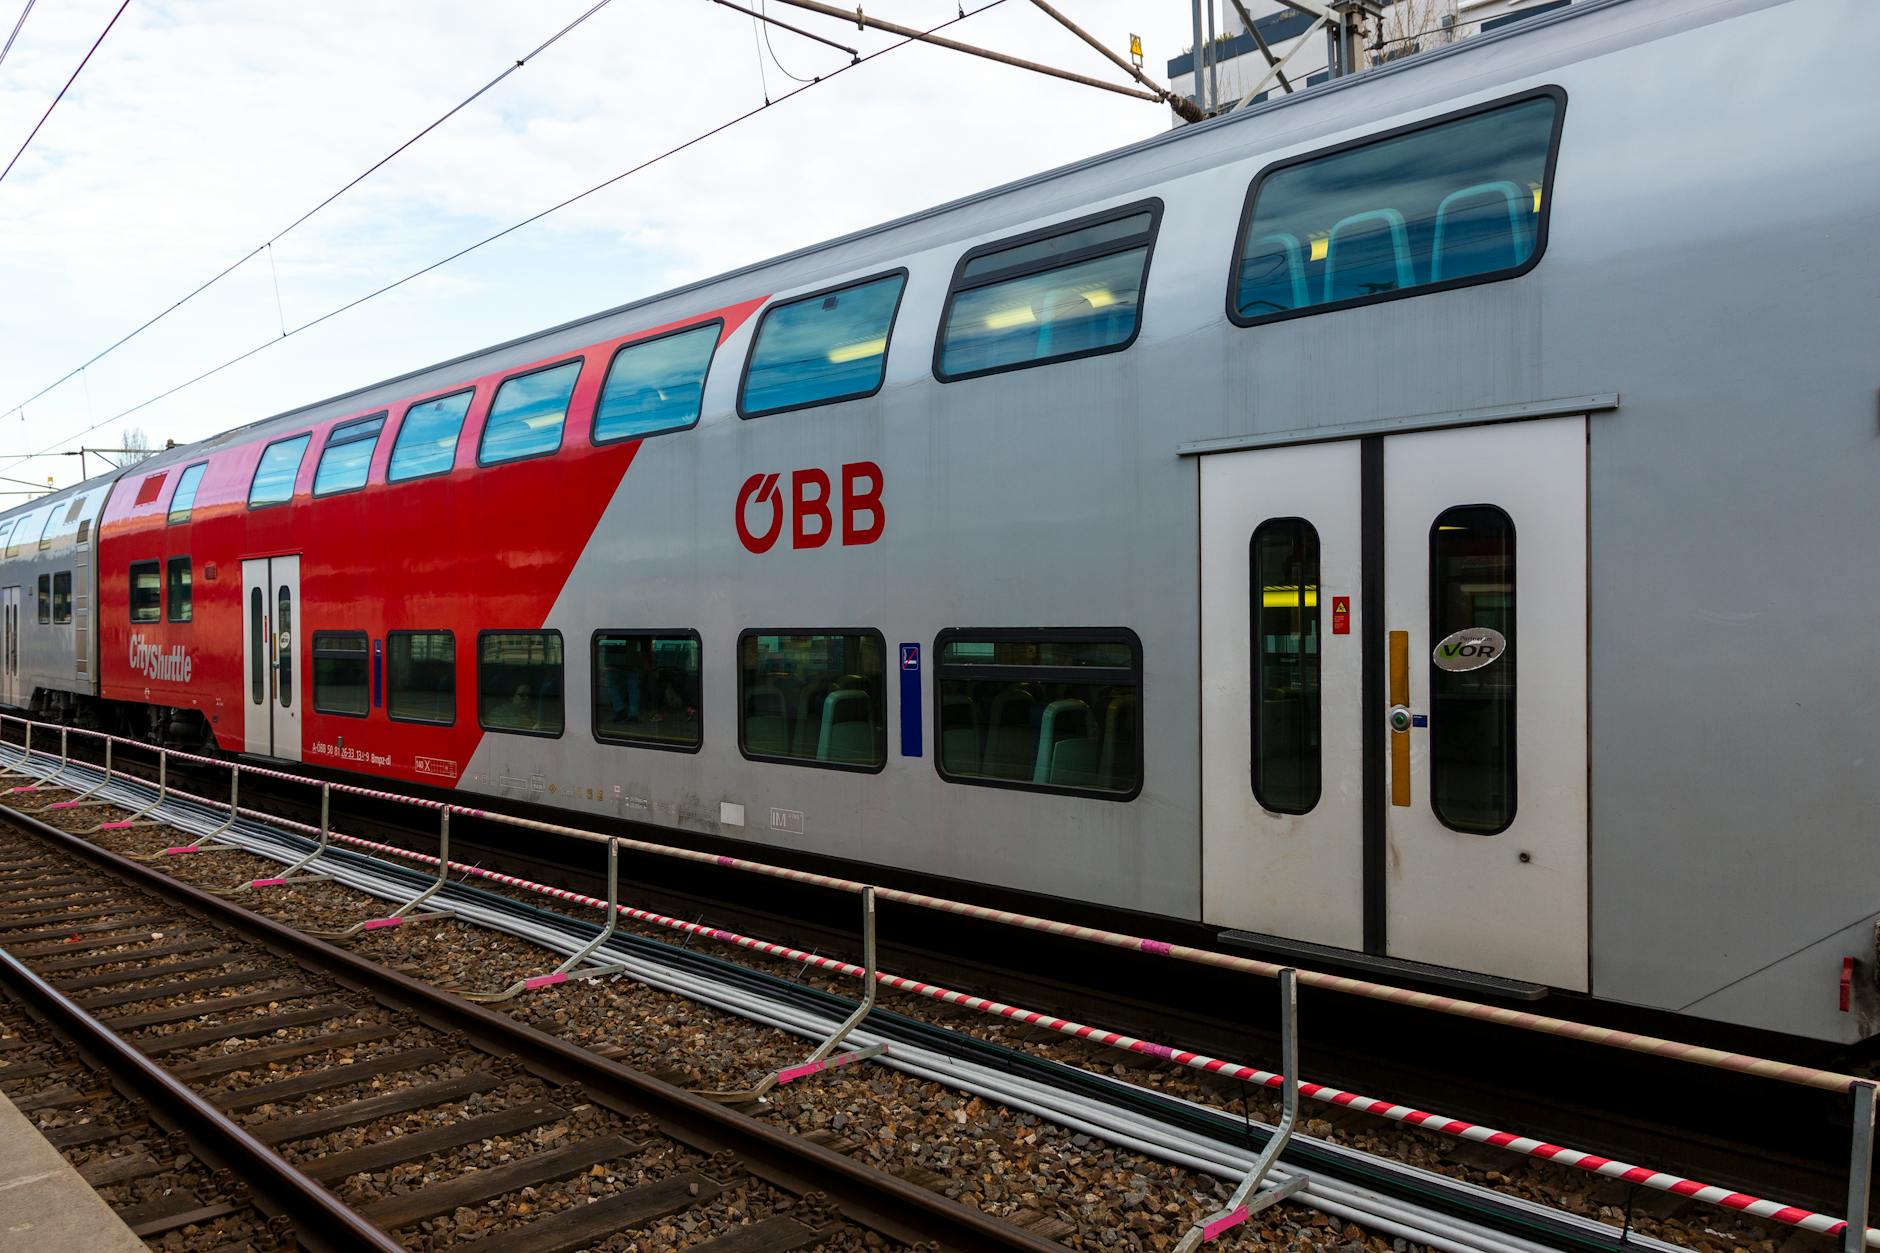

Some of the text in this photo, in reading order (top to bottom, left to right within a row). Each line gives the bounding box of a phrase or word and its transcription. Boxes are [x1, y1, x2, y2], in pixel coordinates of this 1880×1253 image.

[735, 461, 886, 555] ÖBB
[1443, 642, 1495, 658] VOR
[129, 634, 192, 683] CityShuttle
[327, 745, 333, 755] 50
[424, 760, 431, 772] X
